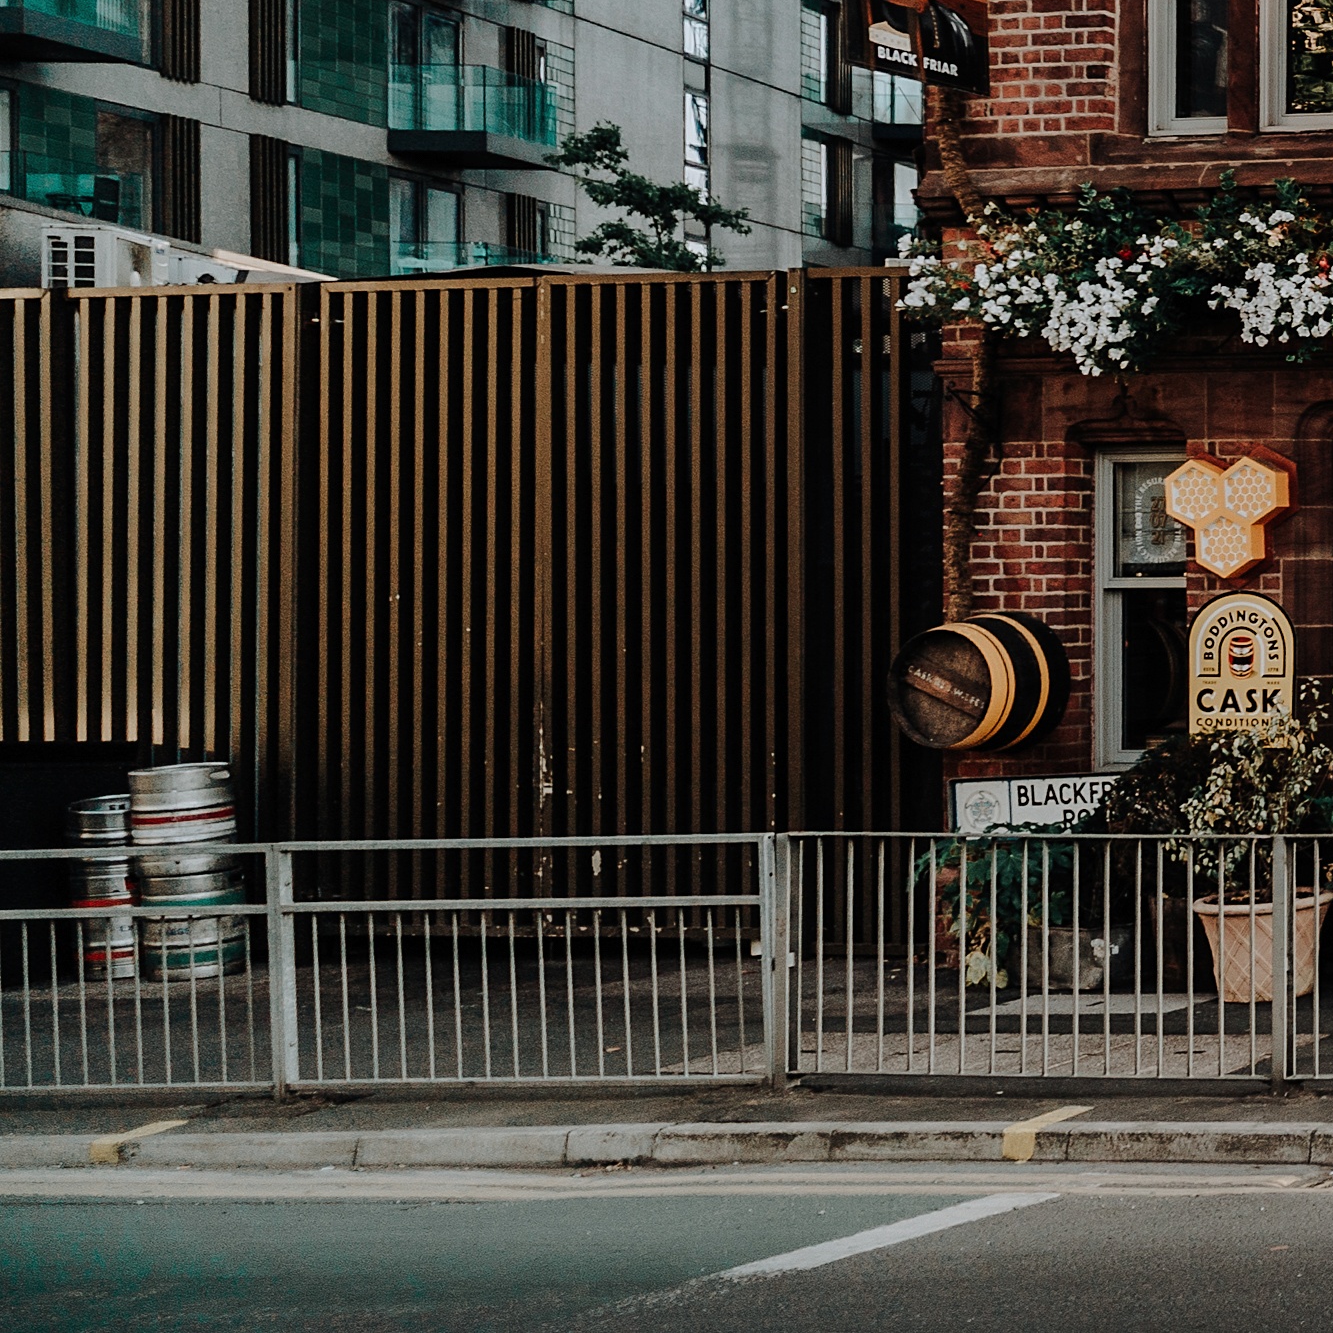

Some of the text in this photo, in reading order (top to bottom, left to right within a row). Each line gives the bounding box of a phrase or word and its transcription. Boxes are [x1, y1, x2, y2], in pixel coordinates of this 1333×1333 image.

[877, 46, 959, 78] BLACK FRIAR
[1203, 610, 1280, 661] BODDINGTONS
[1196, 688, 1282, 714] CASK
[1196, 717, 1285, 728] CONDITIOND
[1017, 781, 1113, 807] BLACKFR
